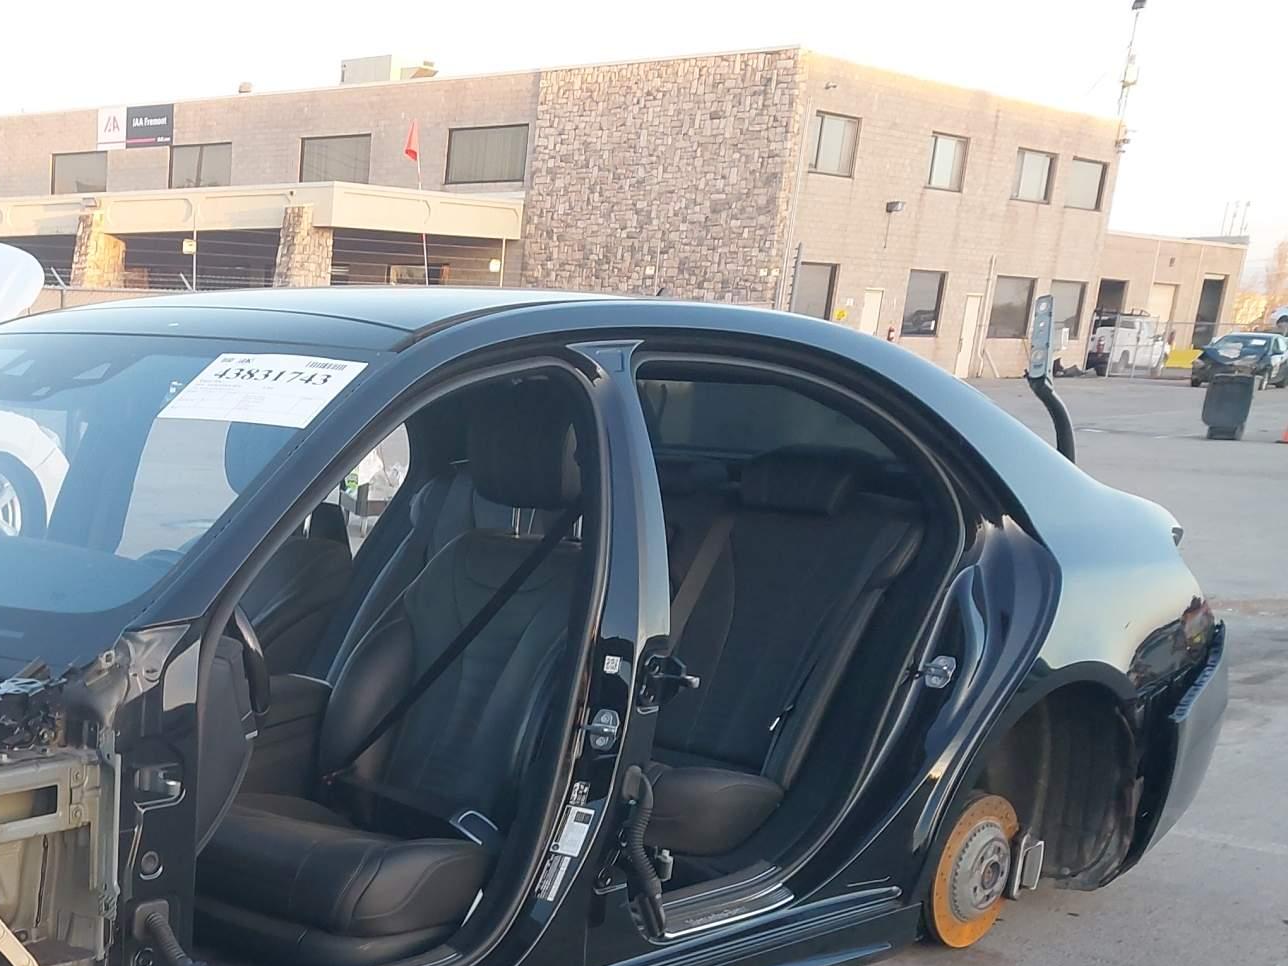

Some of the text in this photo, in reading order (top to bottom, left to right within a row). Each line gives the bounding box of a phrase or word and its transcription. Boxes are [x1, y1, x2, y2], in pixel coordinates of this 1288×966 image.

[132, 116, 167, 128] IAA Fremont
[214, 367, 332, 386] 43831743
